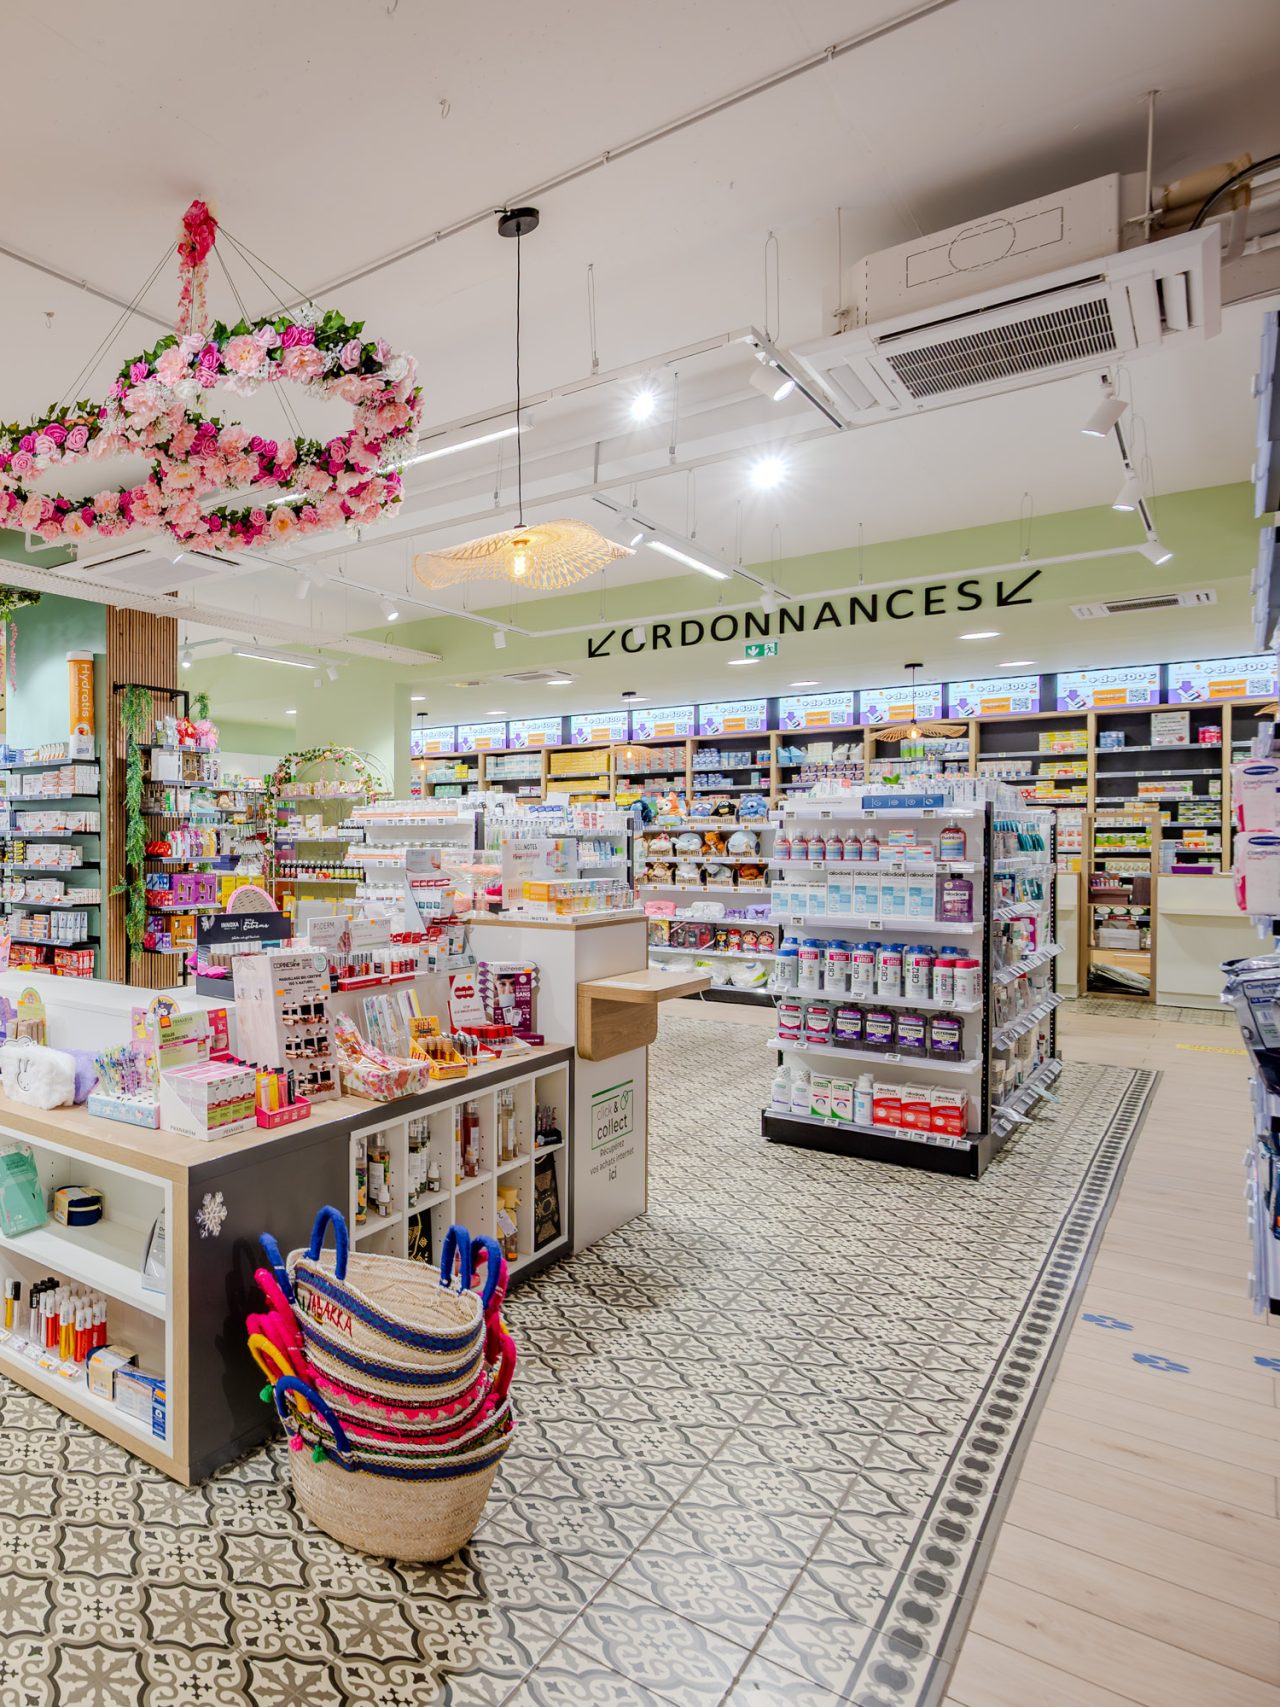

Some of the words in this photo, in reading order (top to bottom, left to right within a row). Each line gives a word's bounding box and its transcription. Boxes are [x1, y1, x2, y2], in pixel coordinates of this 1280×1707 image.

[621, 580, 983, 653] ORDONNANCES
[1216, 665, 1236, 673] de
[1237, 662, 1267, 671] 500
[1099, 675, 1116, 683] de
[1121, 672, 1145, 681] 500
[79, 664, 90, 717] Hydratis
[986, 684, 1001, 692] de
[1003, 682, 1026, 691] 500
[893, 692, 908, 700] de
[911, 690, 930, 698] 500
[597, 1105, 613, 1120] click
[613, 1101, 618, 1113] &
[597, 1114, 628, 1140] collect
[608, 1166, 617, 1181] ici
